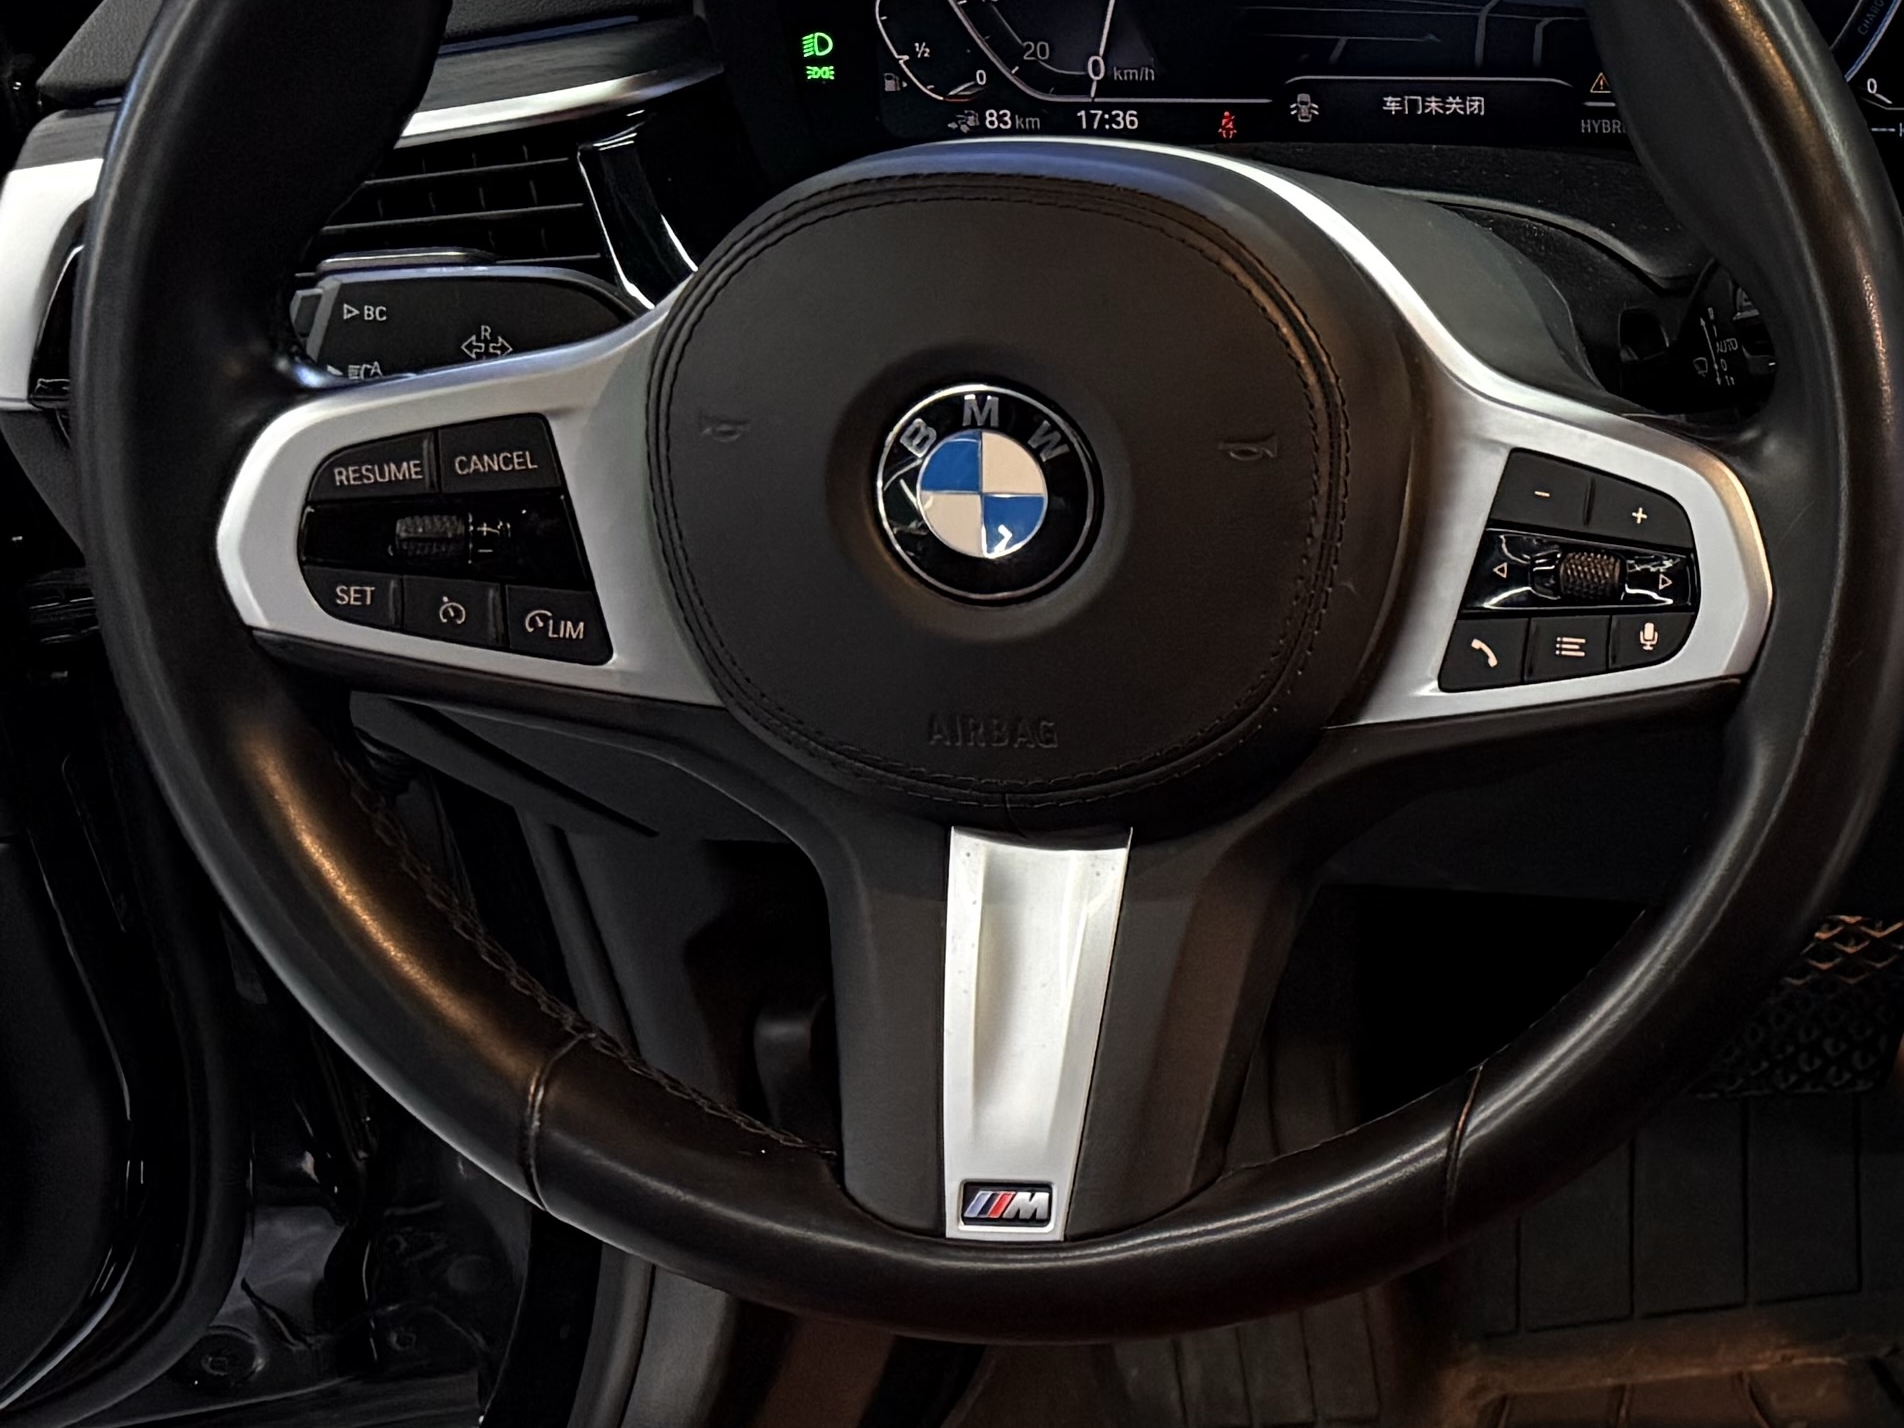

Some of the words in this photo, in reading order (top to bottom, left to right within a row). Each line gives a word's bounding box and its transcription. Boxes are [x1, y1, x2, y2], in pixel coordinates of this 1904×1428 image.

[1022, 42, 1050, 61] 20
[975, 69, 987, 86] 0
[1112, 66, 1156, 82] km/h
[1867, 78, 1877, 93] 0
[1382, 95, 1485, 115] 车门未关闭
[985, 110, 1012, 129] 83
[1014, 113, 1041, 129] km
[1076, 110, 1139, 129] 17:36
[363, 305, 387, 321] BC
[455, 450, 538, 474] CANCEL
[334, 460, 423, 487] RESUME
[335, 586, 375, 606] SET
[548, 616, 585, 640] LIM
